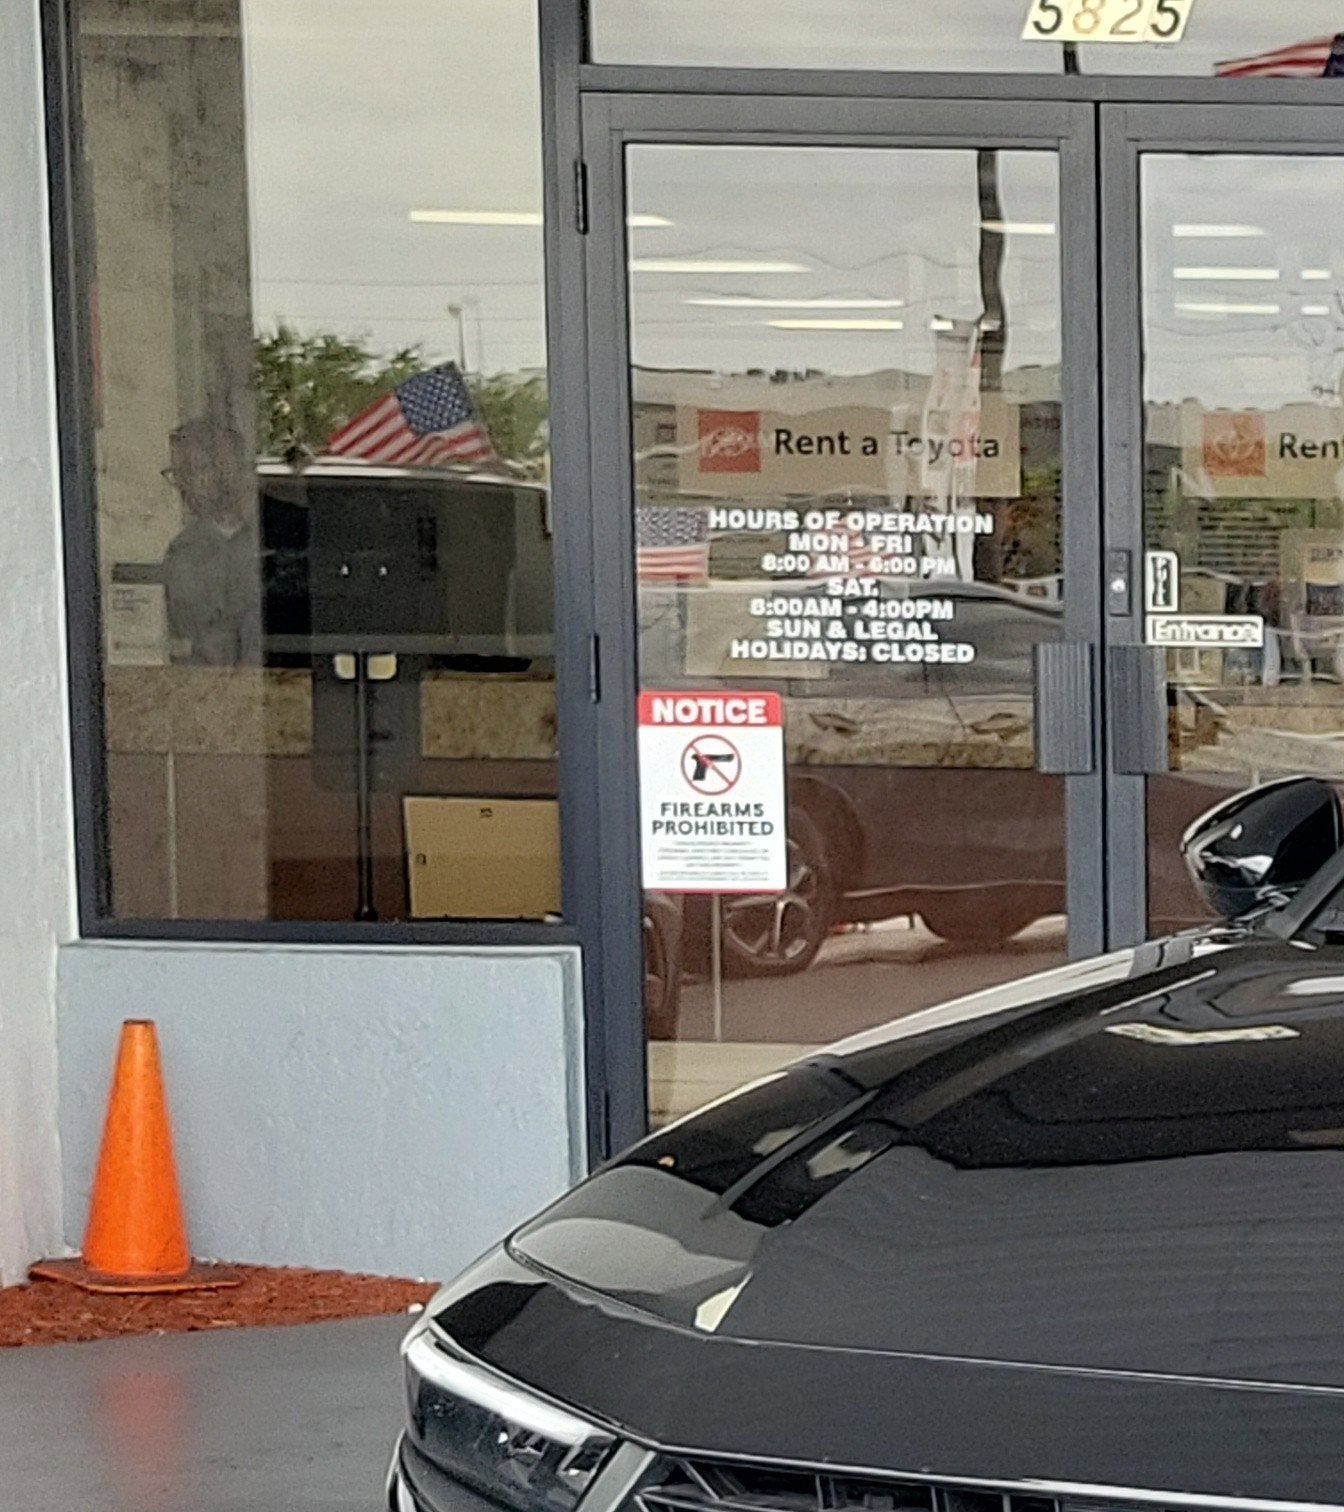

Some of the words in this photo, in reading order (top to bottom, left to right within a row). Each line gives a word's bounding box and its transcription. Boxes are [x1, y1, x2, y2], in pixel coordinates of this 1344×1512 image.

[1032, 0, 1181, 37] 5825
[773, 428, 850, 457] Rent
[861, 435, 879, 457] a
[893, 430, 1000, 466] Toyota
[708, 509, 800, 530] HOURS
[803, 510, 841, 531] OF
[849, 512, 994, 534] OPERATION
[788, 533, 849, 552] MON
[871, 534, 913, 553] FRI
[761, 554, 810, 572] 8:00
[816, 555, 849, 573] AM
[920, 557, 956, 575] PM
[826, 578, 879, 597] SAT.
[749, 598, 843, 617] 8:00AM
[861, 599, 954, 620] 4:00PM
[766, 619, 821, 638] SUN
[826, 620, 848, 639] &
[853, 620, 939, 640] LEGAL
[730, 640, 867, 661] HOLIDAYS:
[871, 642, 976, 664] CLOSED
[651, 697, 768, 724] NOTICE
[660, 802, 765, 818] FIREARMS
[651, 819, 774, 836] PROHIBITED
